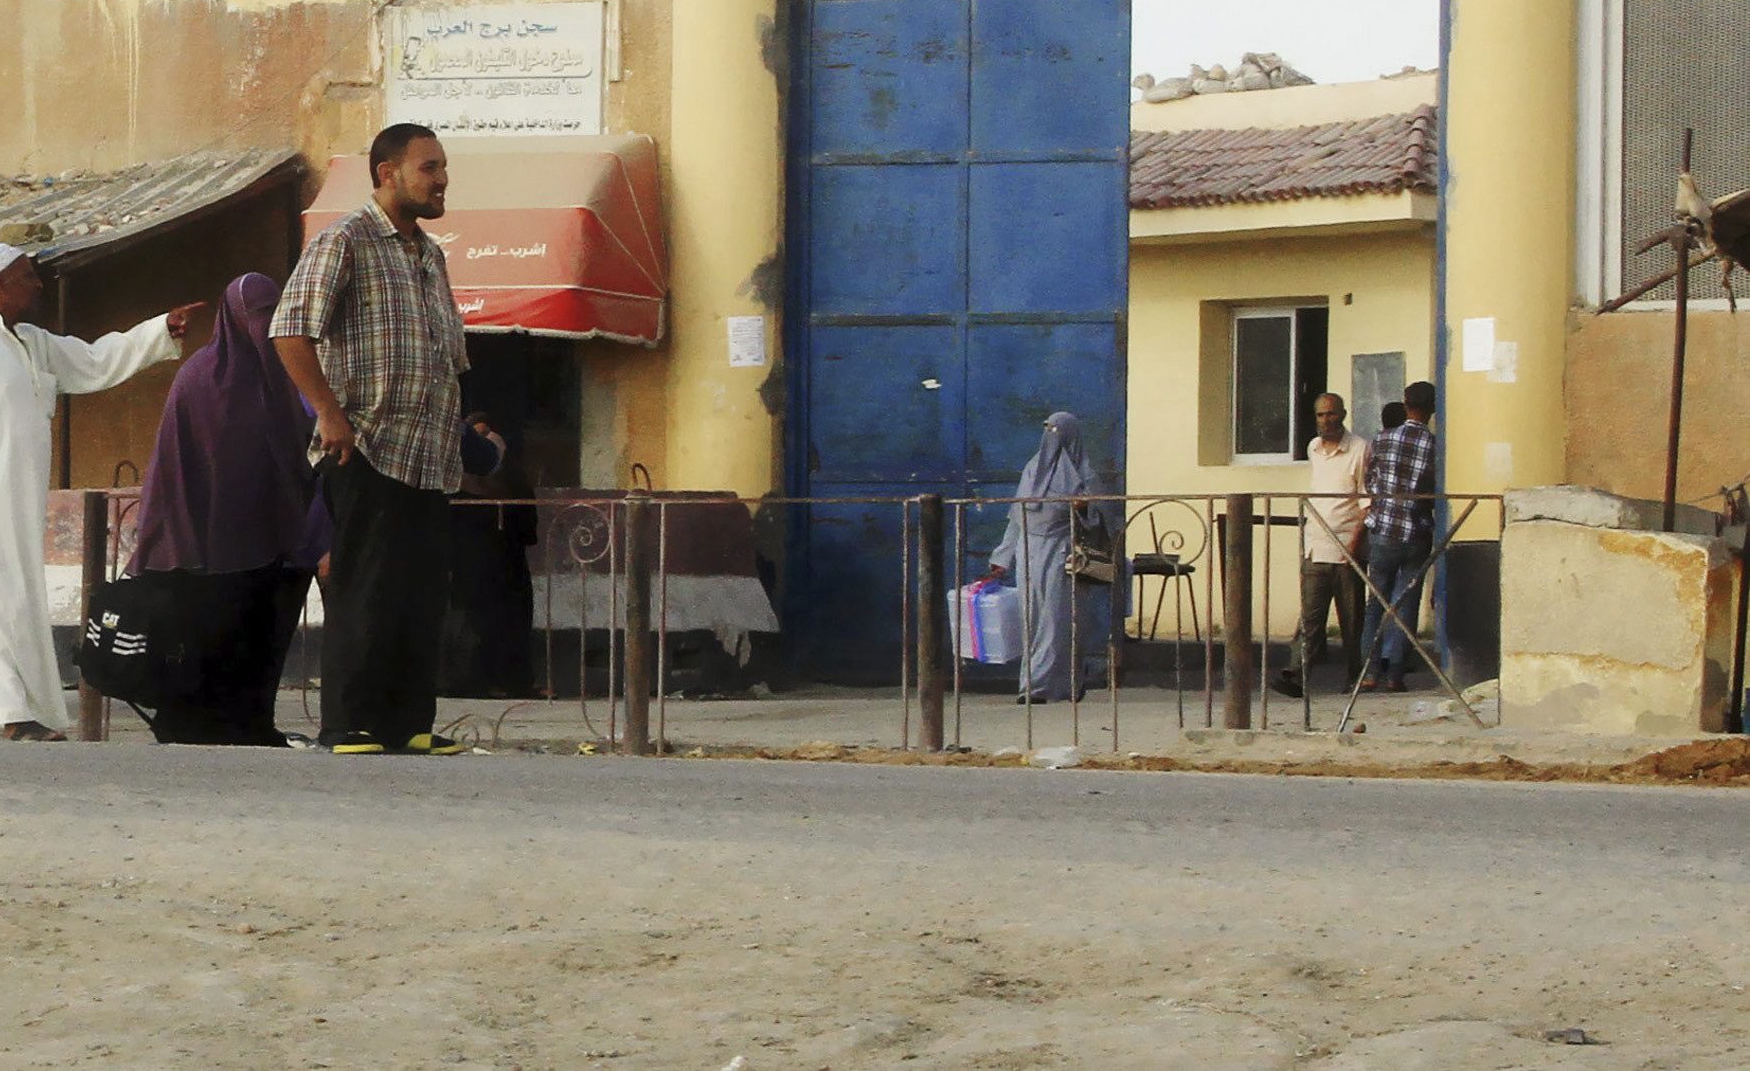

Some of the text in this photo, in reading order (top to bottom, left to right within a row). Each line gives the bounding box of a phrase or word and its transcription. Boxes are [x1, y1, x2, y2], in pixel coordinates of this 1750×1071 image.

[426, 19, 558, 39] سجن برج العرب
